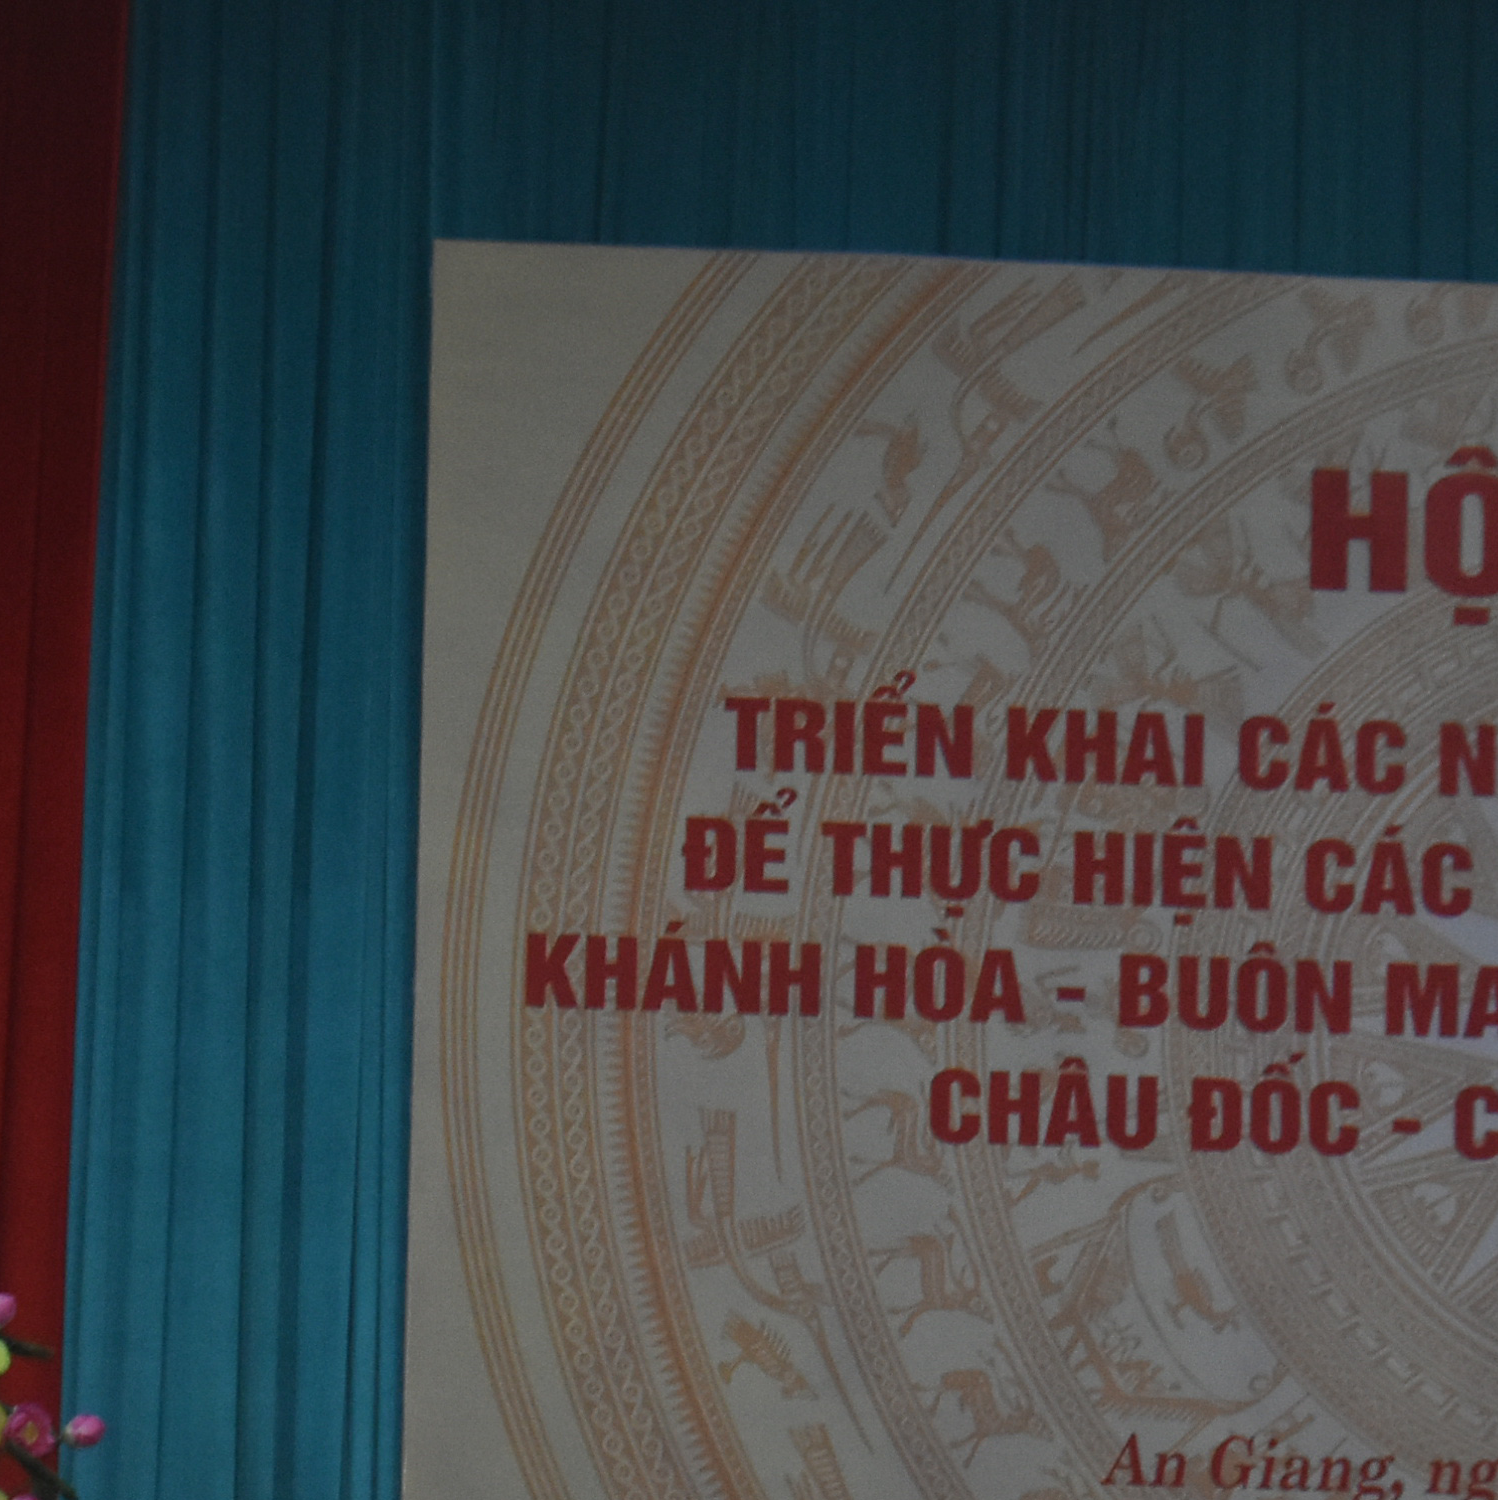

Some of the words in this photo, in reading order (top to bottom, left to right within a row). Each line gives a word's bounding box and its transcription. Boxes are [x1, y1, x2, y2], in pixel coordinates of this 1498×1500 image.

[725, 670, 976, 779] TRIỂN
[1005, 705, 1205, 788] KHAI
[1238, 701, 1407, 795] CÁC
[680, 787, 799, 893] ĐỂ
[821, 818, 1041, 919] THỰC
[1072, 816, 1274, 926] HIỆN
[1304, 824, 1473, 918] CÁC
[524, 920, 822, 1016] KHÁNH
[854, 927, 1027, 1024] HÒA
[1056, 985, 1087, 1002] -
[1118, 941, 1354, 1035] BUÔN
[929, 1056, 1160, 1151] CHÂU
[1187, 1051, 1361, 1157] ĐỐC
[1391, 1117, 1423, 1135] -
[1101, 1434, 1189, 1490] An
